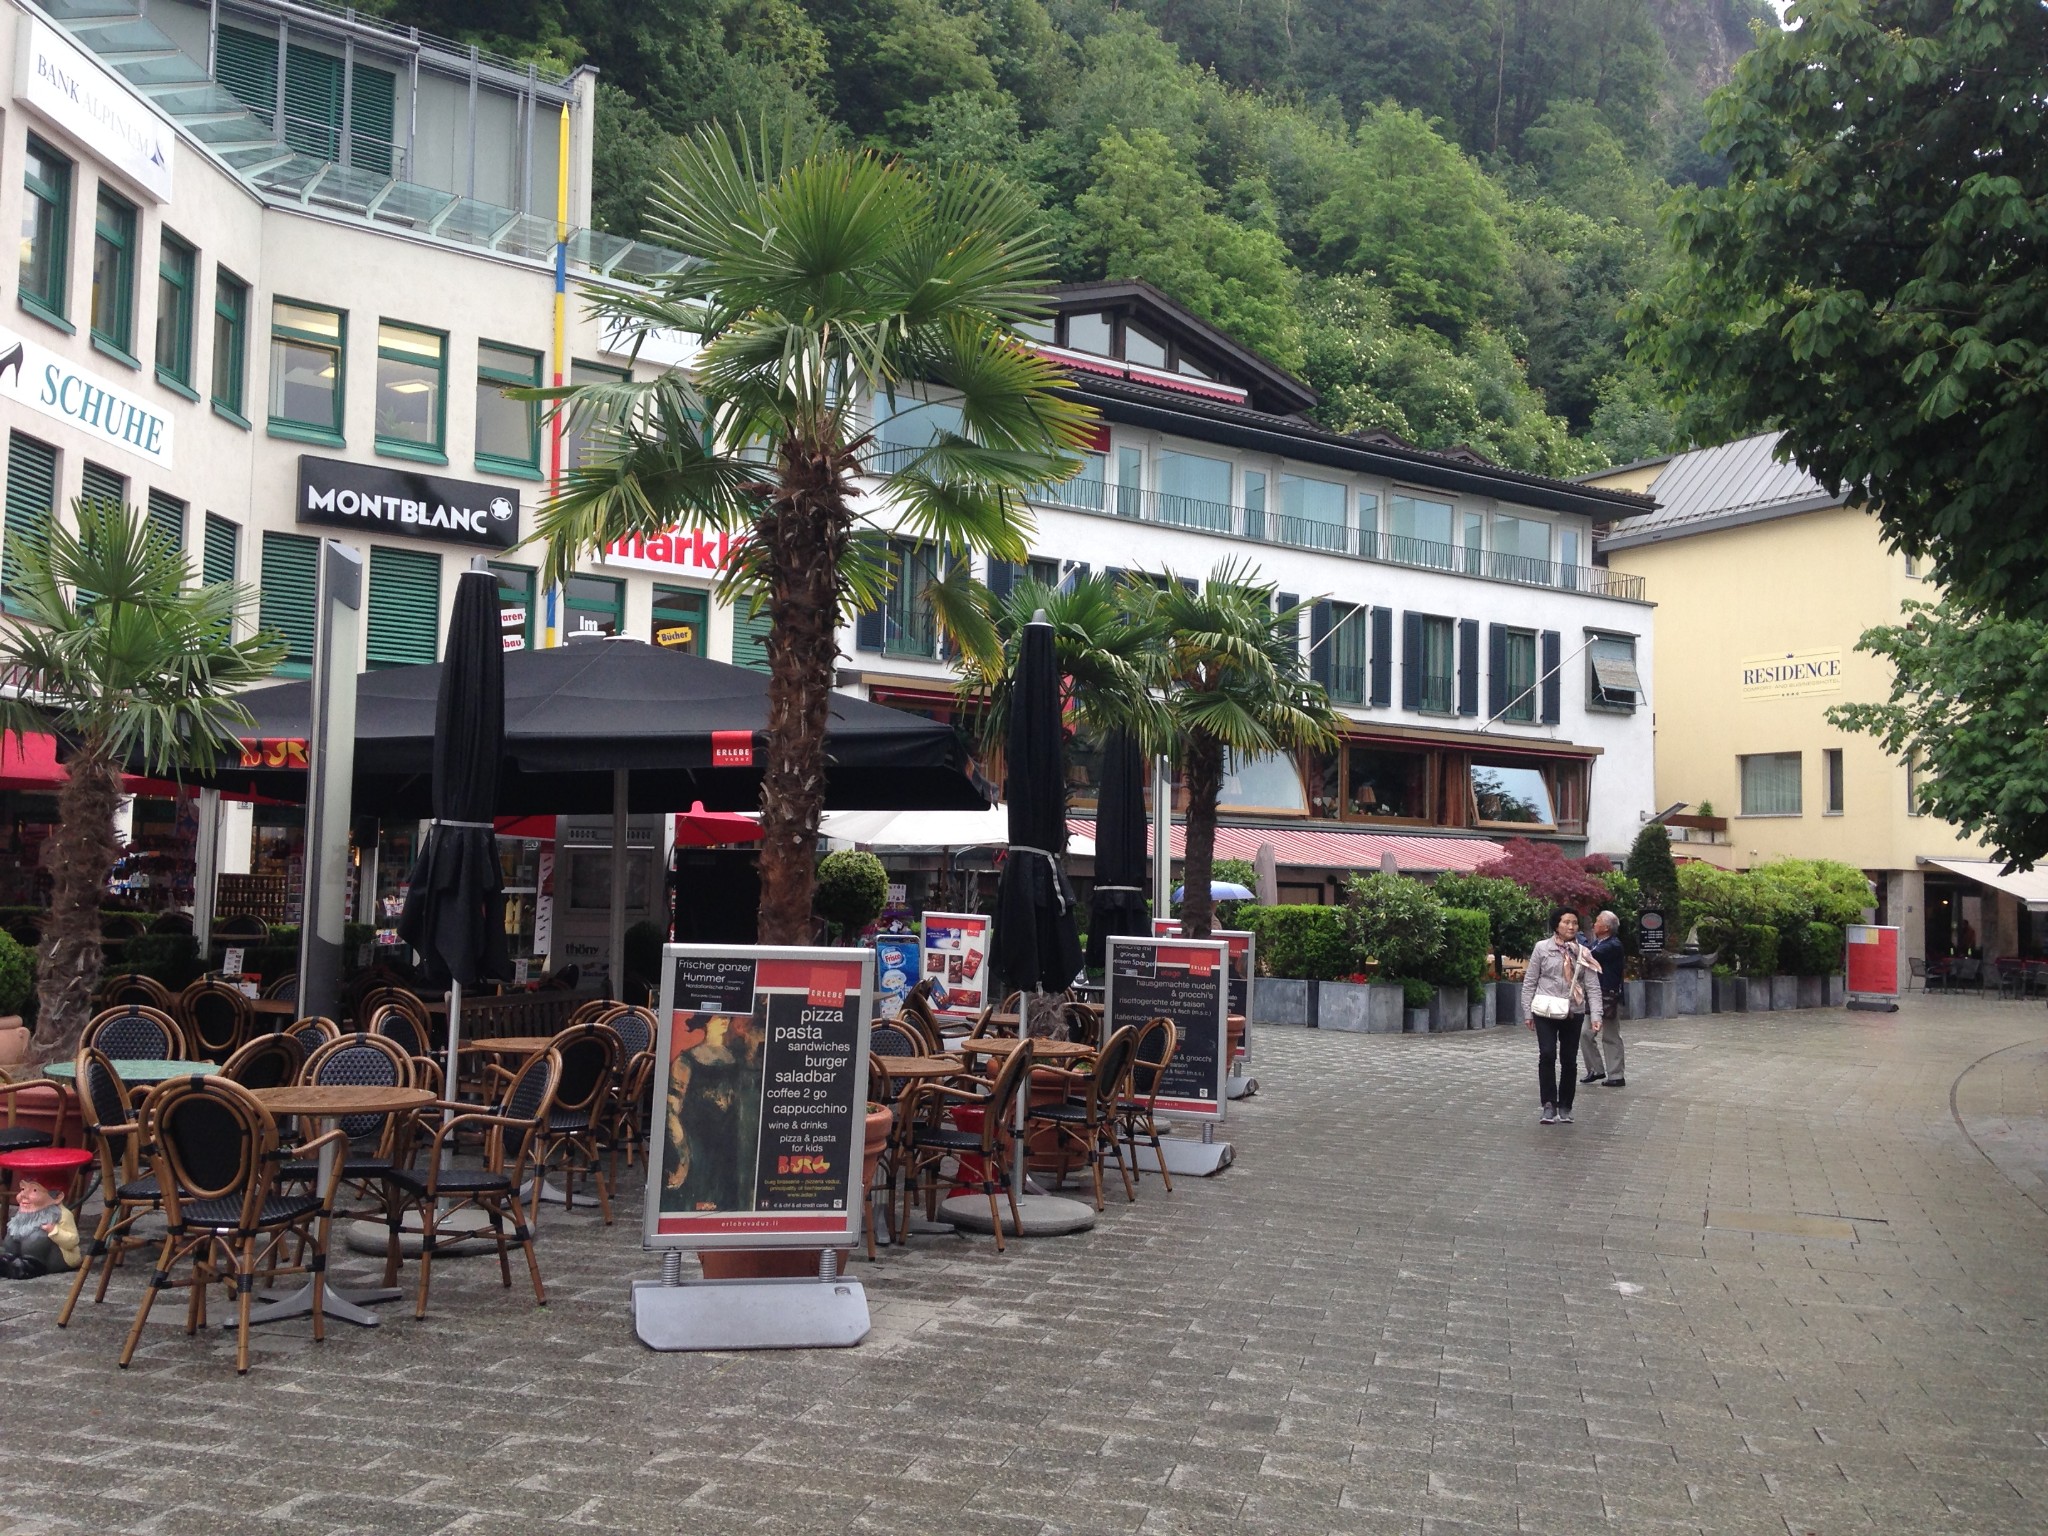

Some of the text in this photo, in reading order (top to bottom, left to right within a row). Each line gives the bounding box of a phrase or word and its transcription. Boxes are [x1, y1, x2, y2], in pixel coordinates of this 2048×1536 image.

[38, 54, 149, 156] BANK ALPINUM
[40, 363, 164, 455] SCHUHE
[307, 485, 488, 534] MONTBLANC
[579, 615, 599, 631] Im
[660, 630, 689, 641] Bücher
[502, 639, 522, 648] bau
[1743, 659, 1841, 685] RESIDENCE
[716, 748, 751, 757] ERLEBE
[884, 952, 902, 963] Frisco
[678, 960, 752, 973] Frischer ganzer
[682, 972, 726, 983] Hummer
[1136, 979, 1217, 990] hausgemachte nudeln
[811, 989, 843, 999] ERLEBE
[1170, 989, 1214, 1000] & gnocchi's
[1119, 996, 1206, 1008] risottogerichte der saison
[800, 1007, 844, 1025] pizza
[775, 1025, 823, 1042] pasta
[788, 1042, 850, 1052] sandwiches
[805, 1055, 848, 1070] burger
[1186, 1055, 1213, 1063] gnocchi
[775, 1069, 837, 1082] saladbar
[766, 1088, 828, 1100] coffee 2 go
[773, 1103, 848, 1116] cappucchino
[768, 1121, 828, 1130] wine & drinks
[779, 1134, 837, 1144] pizza & pasta
[791, 1144, 824, 1152] for kids
[778, 1155, 831, 1174] BURG
